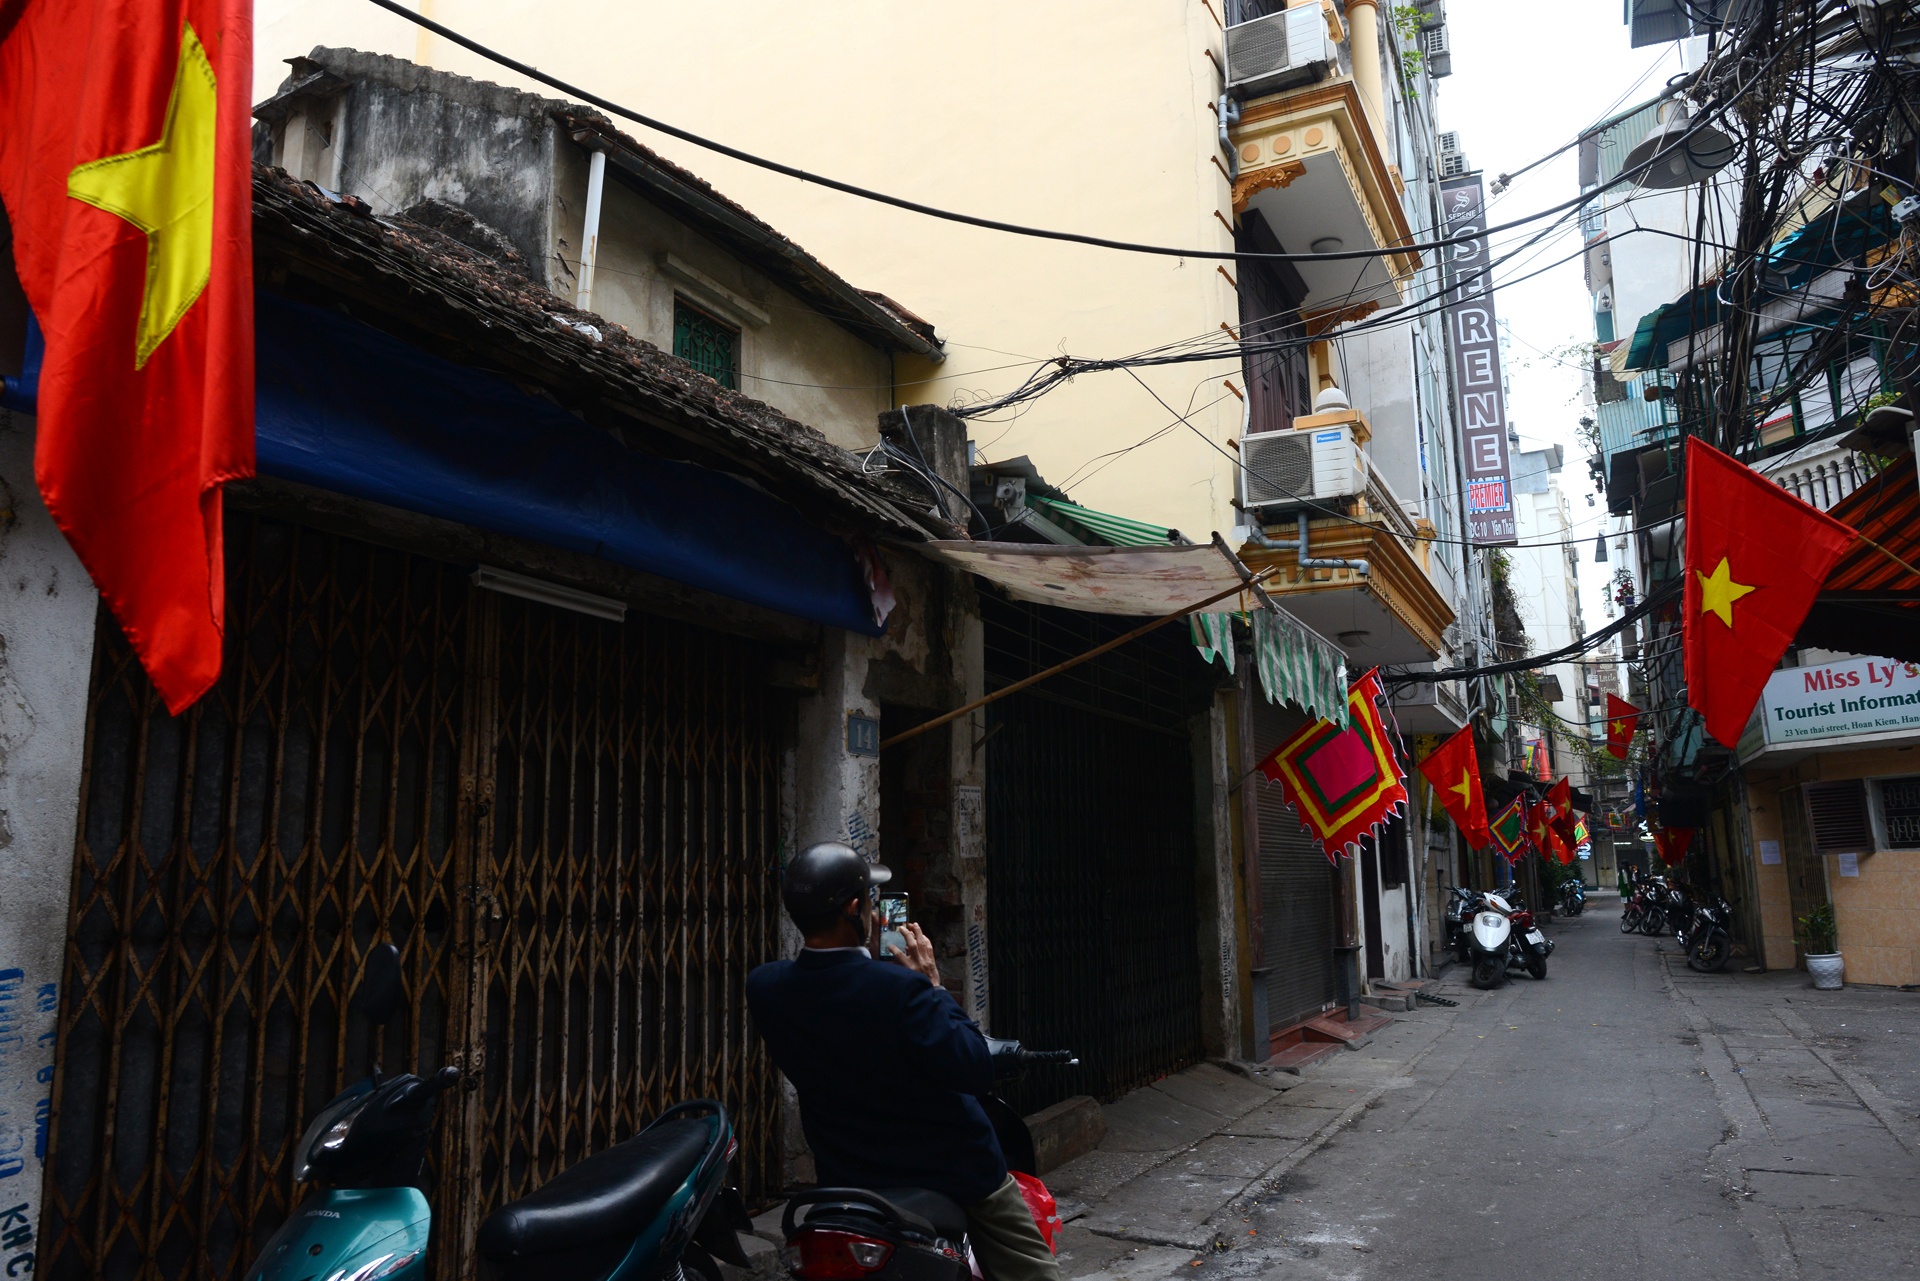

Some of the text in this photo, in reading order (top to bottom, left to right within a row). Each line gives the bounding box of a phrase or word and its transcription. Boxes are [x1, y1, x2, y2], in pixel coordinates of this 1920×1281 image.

[1448, 209, 1476, 221] SERENE
[1452, 226, 1501, 472] SERENE
[1469, 482, 1505, 509] PREMIER
[1804, 668, 1860, 693] Miss
[1774, 701, 1836, 722] Tourist
[856, 723, 872, 751] 14
[1784, 729, 1793, 738] 23
[1794, 727, 1809, 736] Yen
[1809, 725, 1825, 734] thai
[1826, 722, 1850, 732] street,
[1851, 720, 1873, 729] Hoan
[1875, 717, 1900, 727] Kiem,
[304, 1209, 341, 1219] HONDA
